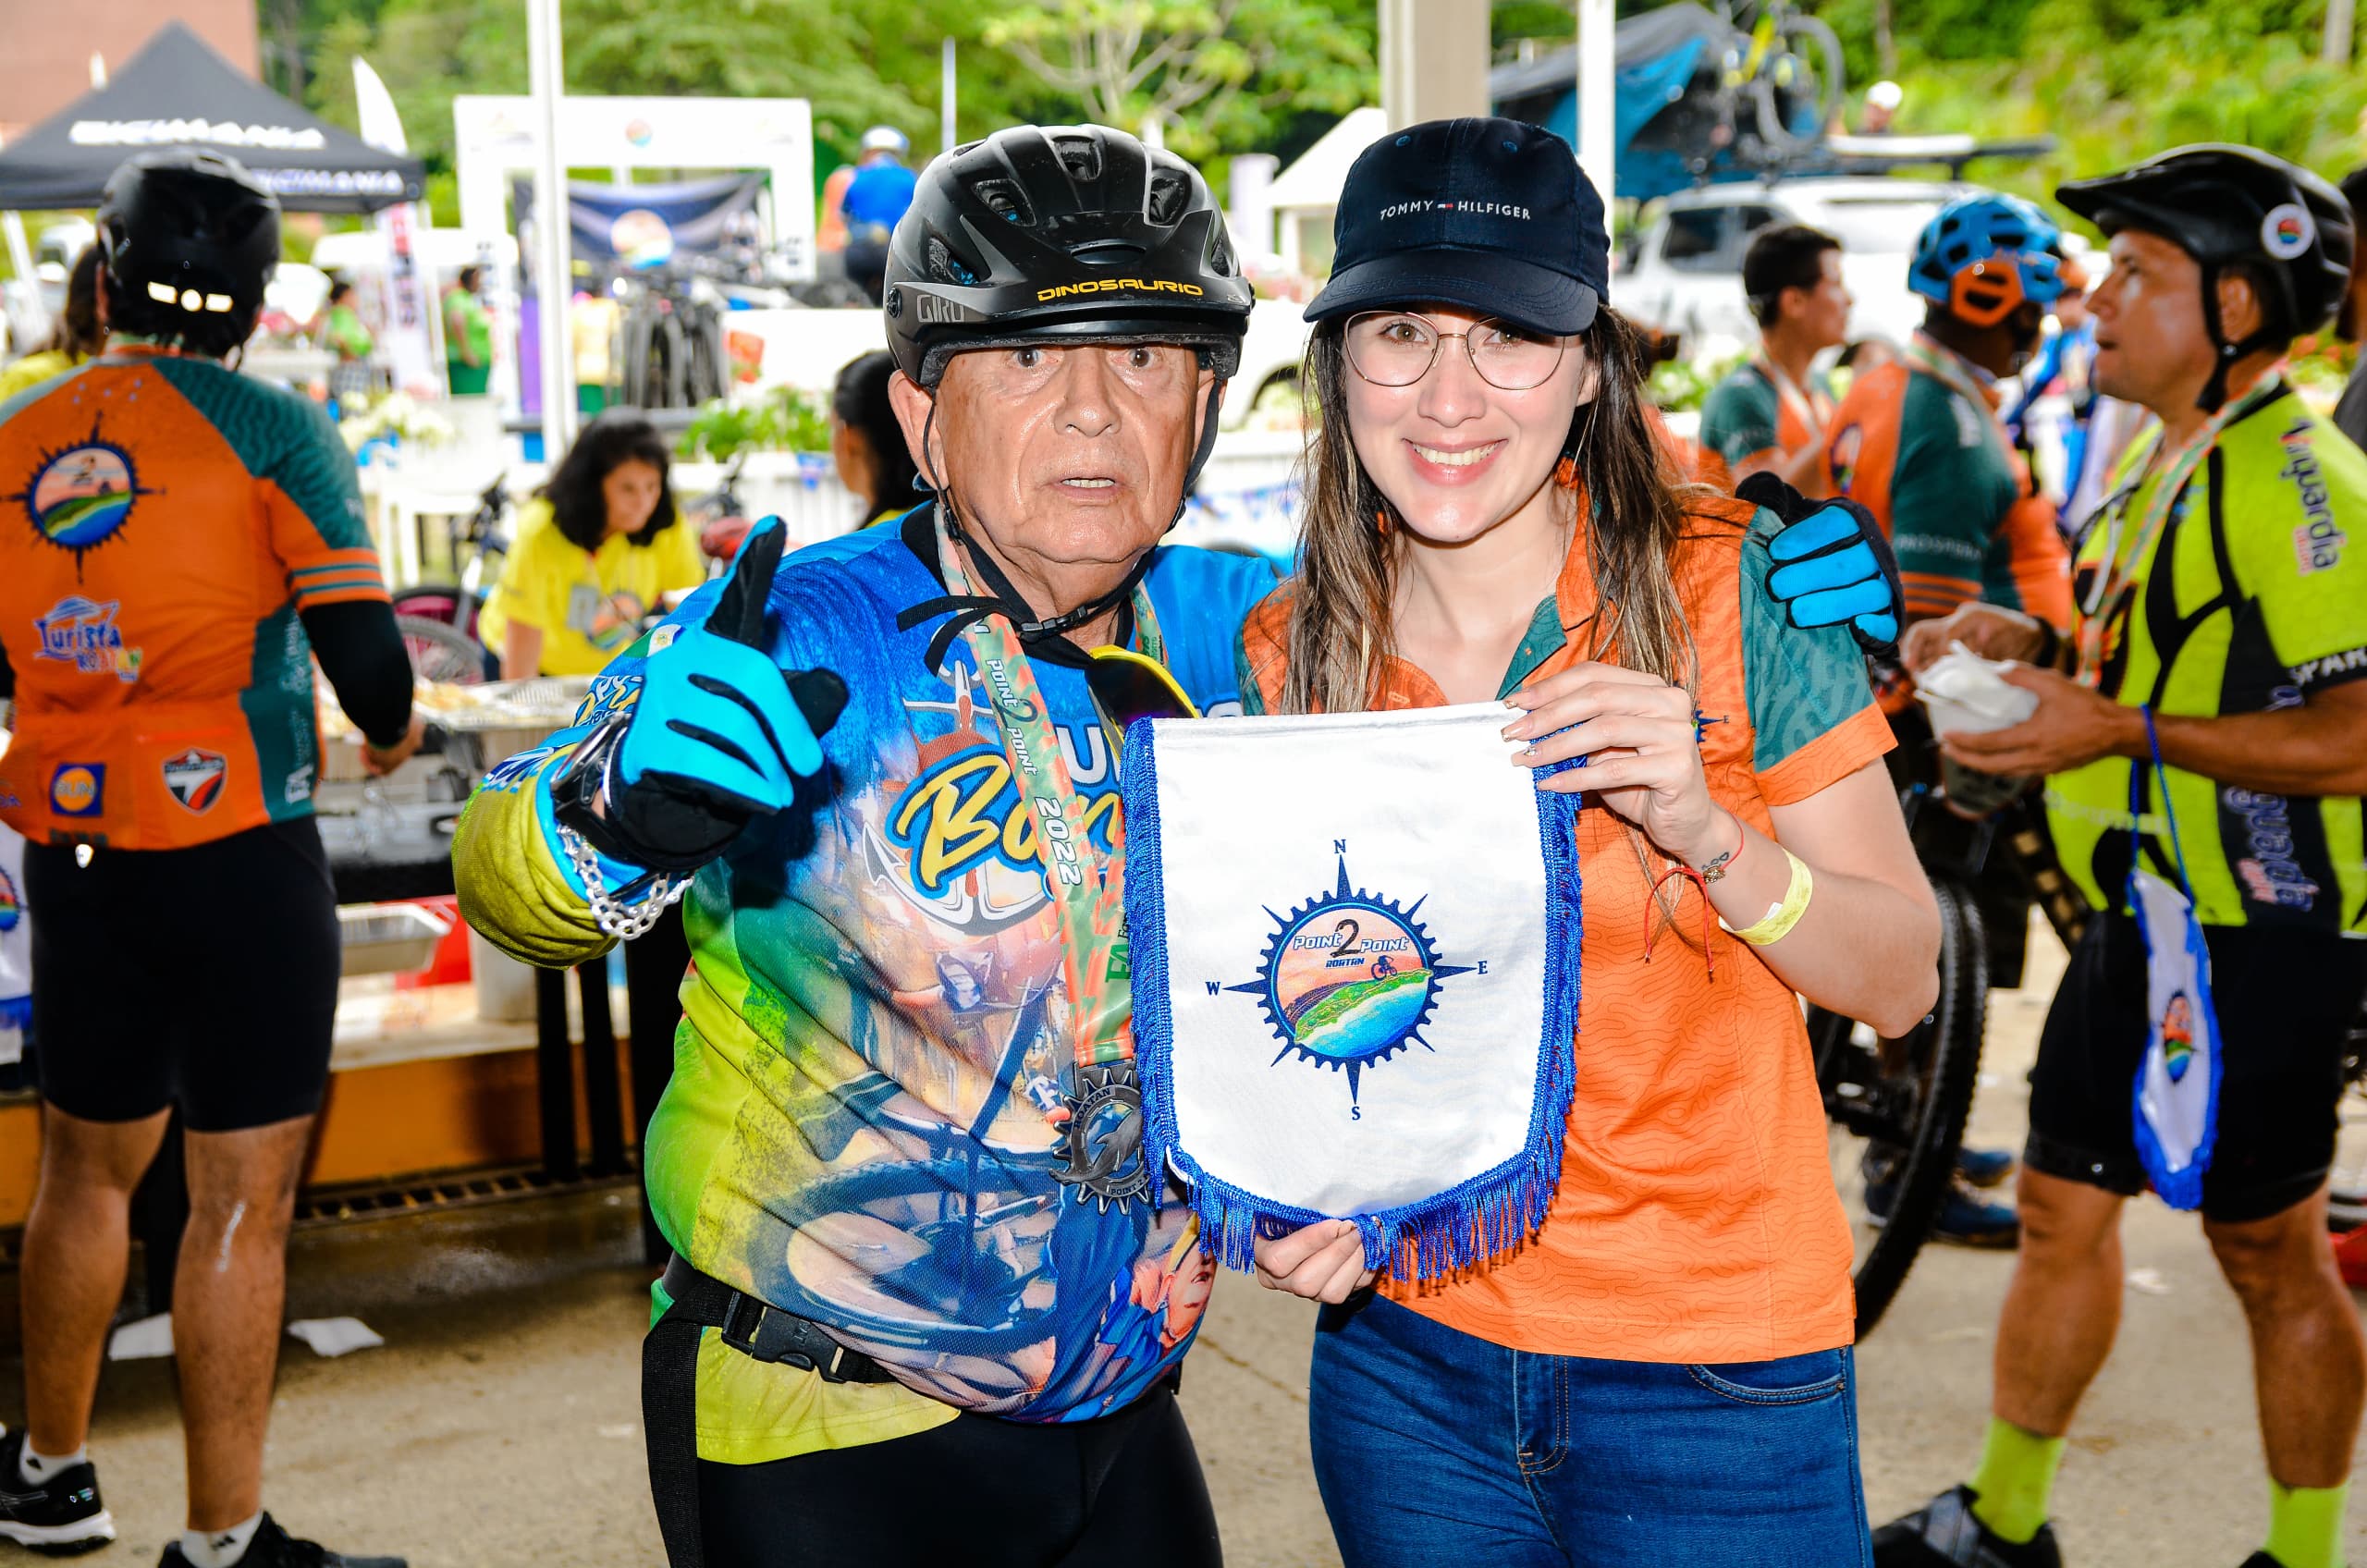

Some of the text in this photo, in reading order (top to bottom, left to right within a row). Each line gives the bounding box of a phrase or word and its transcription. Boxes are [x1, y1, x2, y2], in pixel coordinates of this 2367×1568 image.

[1380, 201, 1531, 221] TOMMY HILFIGER
[1036, 278, 1204, 302] DINOSAURIO
[916, 294, 965, 323] GIRO
[1035, 796, 1084, 887] 2022
[1333, 839, 1346, 853] N
[1330, 918, 1360, 958] 2
[1326, 957, 1365, 968] ROATAN
[1478, 961, 1488, 974] E
[1206, 982, 1220, 996] W
[1074, 1088, 1111, 1128] ROATAN
[1352, 1107, 1361, 1121] S
[1110, 1184, 1137, 1195] POINT
